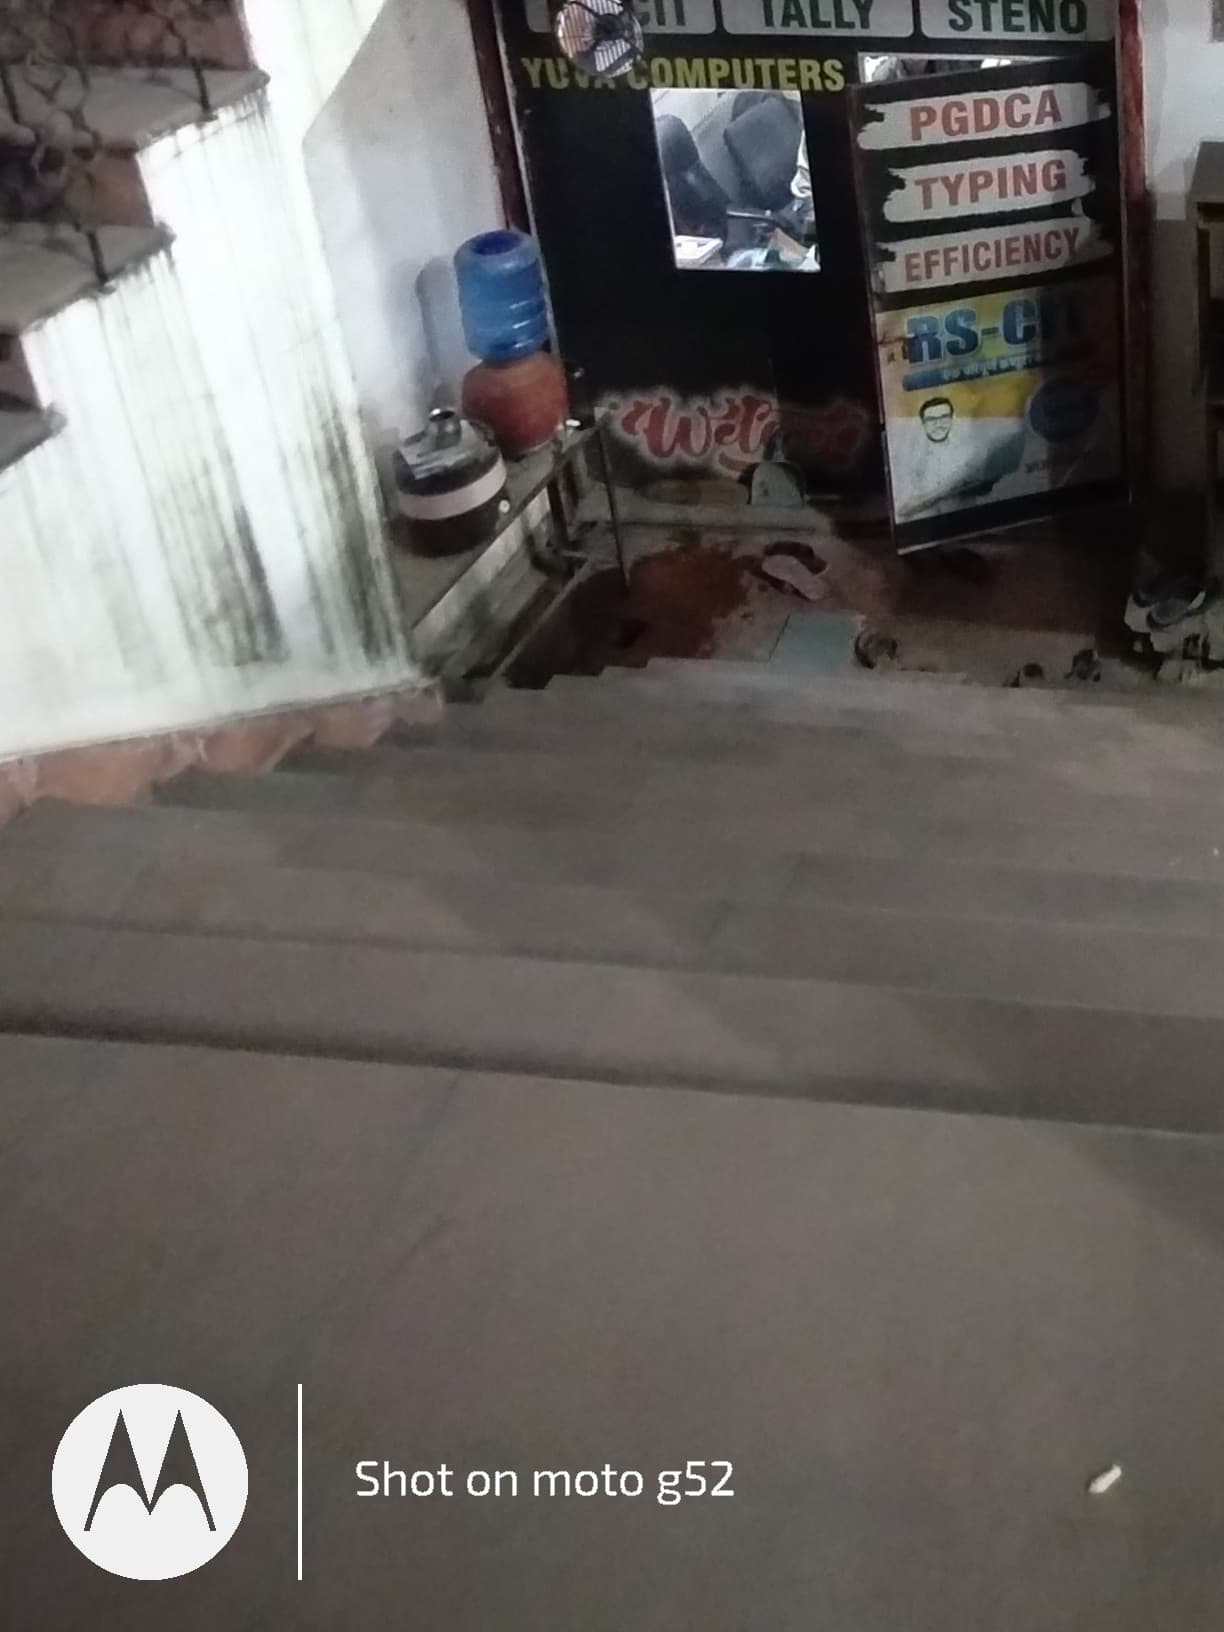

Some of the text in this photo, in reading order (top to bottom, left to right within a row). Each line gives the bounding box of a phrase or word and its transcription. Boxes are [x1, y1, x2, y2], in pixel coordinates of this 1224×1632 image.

[632, 57, 845, 92] COMPUTERS
[910, 89, 1062, 141] PGDCA
[915, 159, 1067, 210] TYPING
[905, 227, 1079, 283] EFFICIENCY
